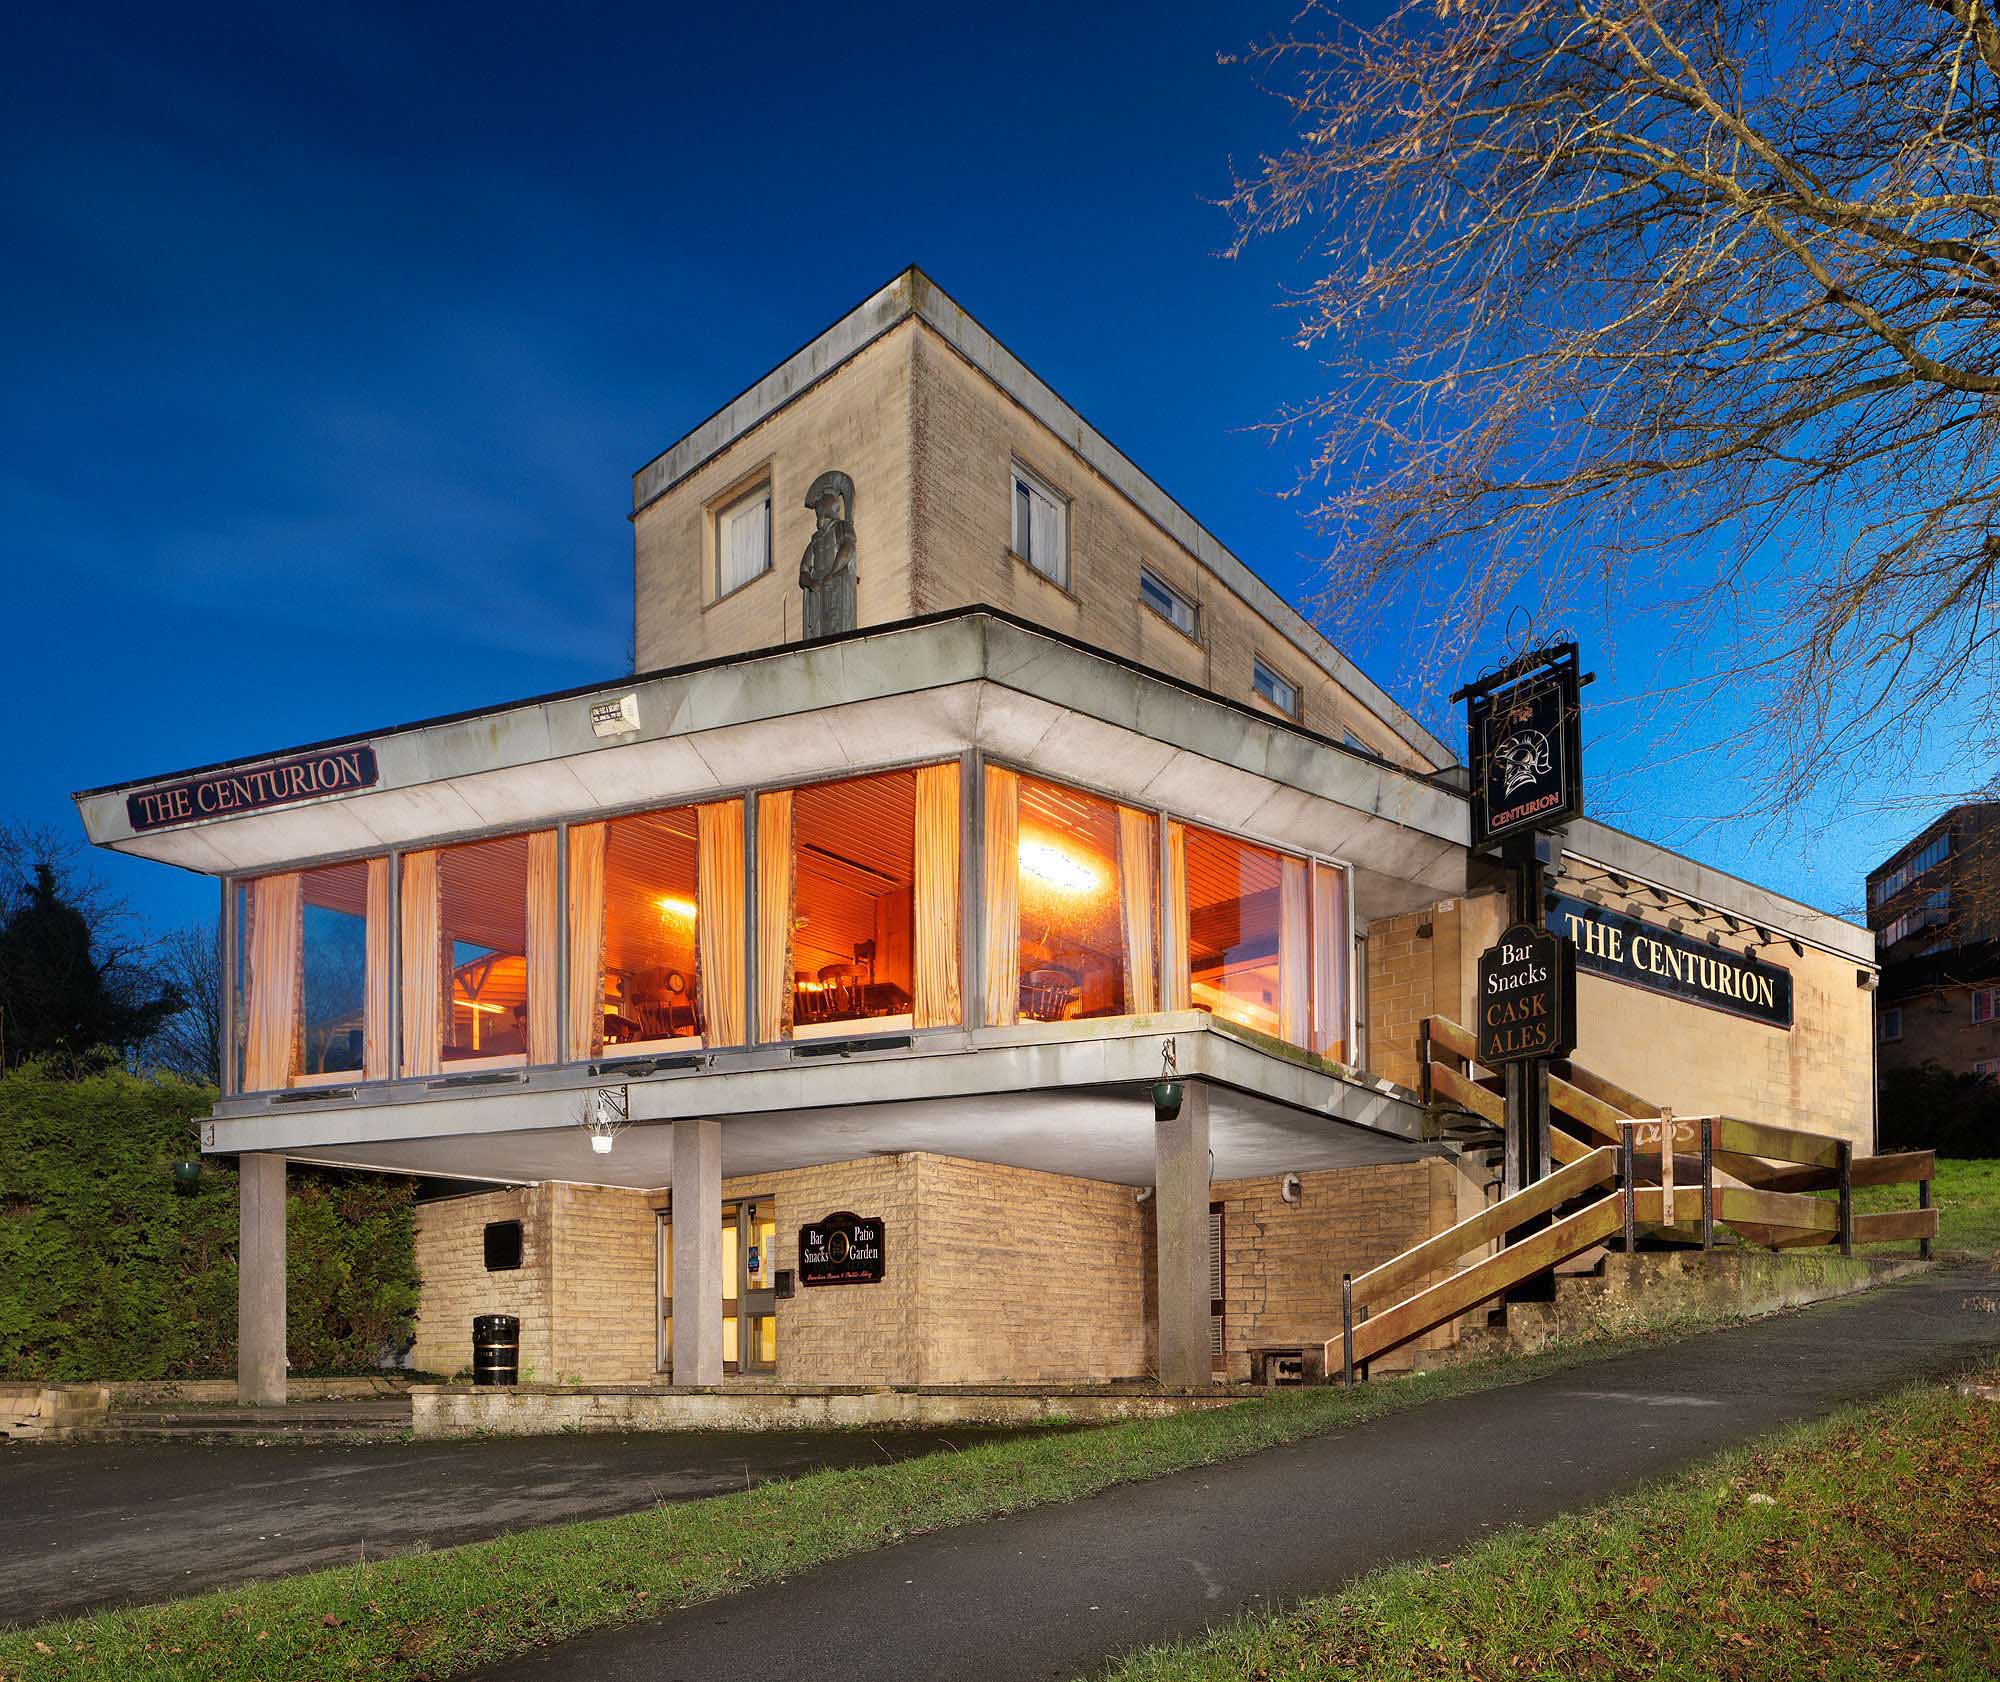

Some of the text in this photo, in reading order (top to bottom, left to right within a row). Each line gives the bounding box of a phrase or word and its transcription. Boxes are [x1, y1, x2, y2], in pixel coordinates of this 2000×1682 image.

[138, 753, 362, 823] THE CENTURION
[1491, 792, 1560, 827] CENTURION
[1501, 944, 1533, 966] Bar
[1565, 912, 1775, 1008] THE CENTURION
[1487, 963, 1547, 994] Snacks
[1487, 993, 1548, 1026] CASK
[1489, 1023, 1547, 1055] ALES
[810, 1230, 824, 1245] Bar
[854, 1225, 874, 1241] Patio
[804, 1246, 829, 1263] Snacks
[849, 1243, 878, 1260] Garden
